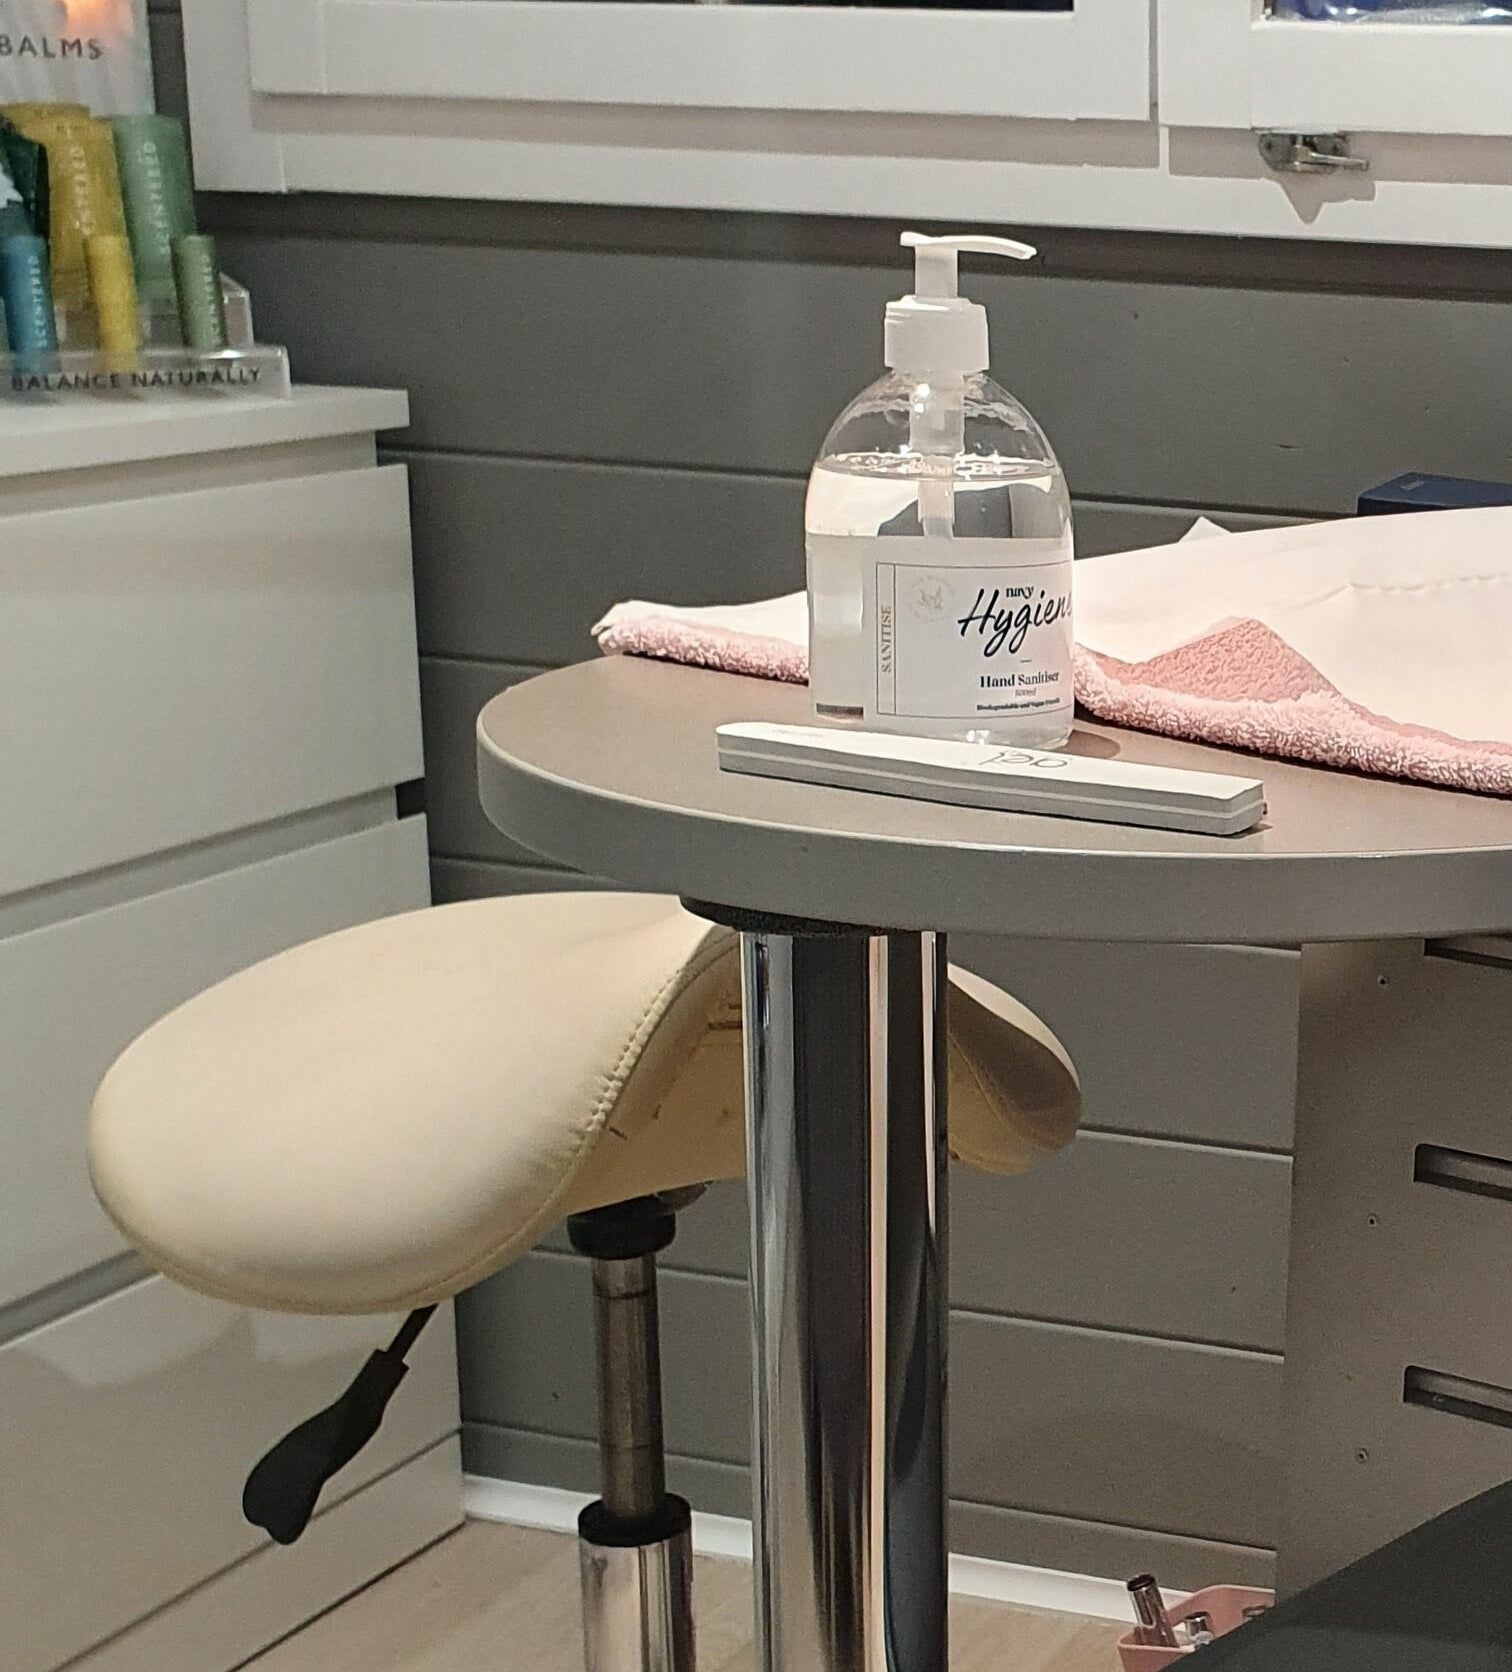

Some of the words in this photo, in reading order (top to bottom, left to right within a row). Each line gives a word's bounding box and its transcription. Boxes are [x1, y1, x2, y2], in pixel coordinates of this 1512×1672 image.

[0, 33, 103, 60] BALMS
[11, 371, 121, 391] BALANCE
[132, 367, 260, 388] NATURALLY
[1005, 585, 1035, 599] navy
[880, 604, 892, 674] SANITISE
[980, 673, 1015, 688] Hand
[1018, 668, 1060, 686] Sanitiser
